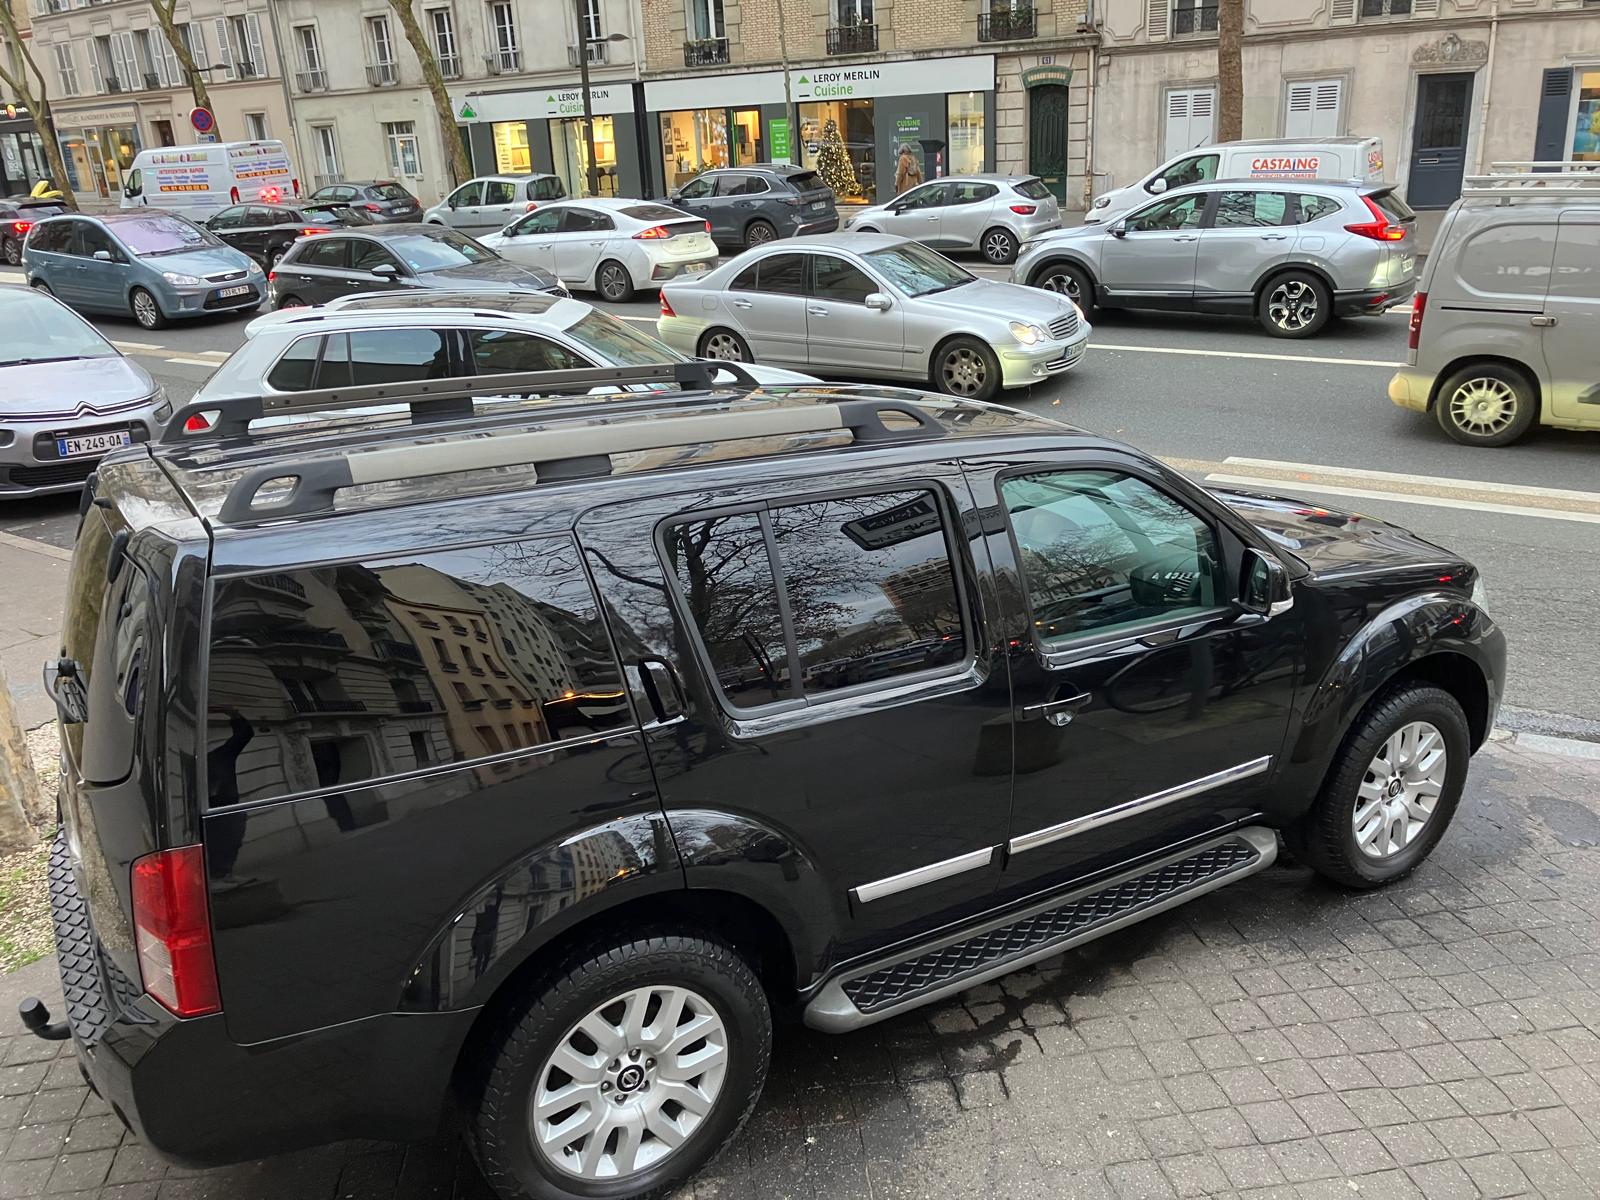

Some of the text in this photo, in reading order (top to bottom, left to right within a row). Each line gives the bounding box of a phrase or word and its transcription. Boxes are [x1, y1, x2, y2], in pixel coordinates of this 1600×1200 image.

[813, 70, 880, 83] LEROY MERLIN
[814, 83, 853, 97] Cuisine
[558, 92, 580, 102] LEROY
[559, 102, 585, 113] Cuisin
[1252, 157, 1318, 171] CASTAING
